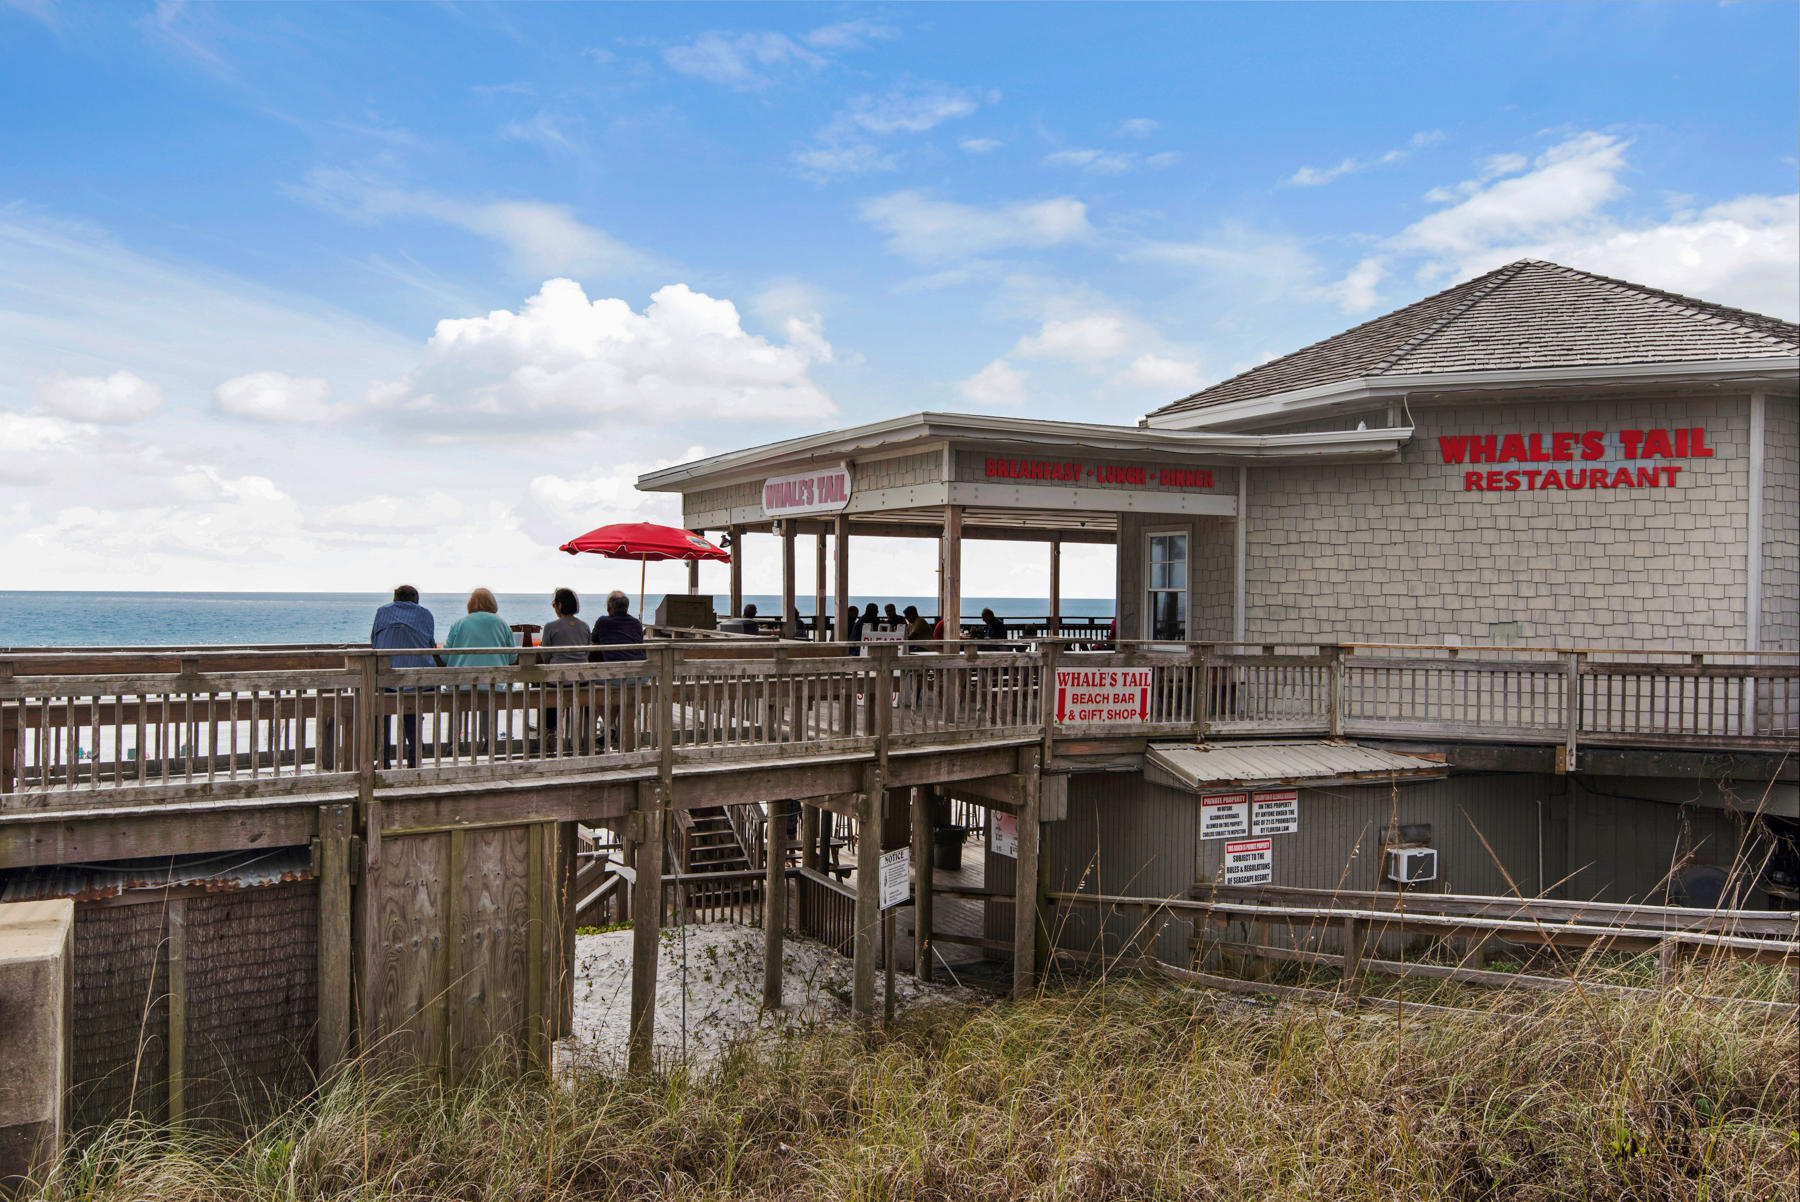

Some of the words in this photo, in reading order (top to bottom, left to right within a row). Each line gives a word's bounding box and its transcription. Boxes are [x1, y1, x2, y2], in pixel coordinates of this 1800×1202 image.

[1438, 430, 1605, 464] WHALE'S
[1620, 427, 1714, 459] TAIL
[985, 458, 1083, 482] BREAKFAST
[1097, 465, 1146, 485] LUNCH
[1160, 469, 1214, 489] DINNER
[1464, 466, 1683, 491] RESTAURANT
[765, 478, 815, 510] WHALE'S
[816, 473, 848, 504] TAIL
[1057, 672, 1118, 687] WHALE'S
[1122, 672, 1150, 687] TAIL
[1072, 693, 1110, 704] BEACH
[1113, 693, 1135, 704] BAR
[1068, 709, 1075, 721] &
[1079, 709, 1104, 721] GIFT
[1106, 709, 1137, 720] SHOP
[1275, 816, 1296, 824] PROHIBITED
[884, 850, 904, 865] NOTICE
[1233, 854, 1250, 862] SUBJECT
[1251, 853, 1256, 861] TO
[1227, 865, 1239, 873] RULES
[1244, 863, 1270, 872] REGULATIONS
[1233, 875, 1253, 884] SEASCAPE
